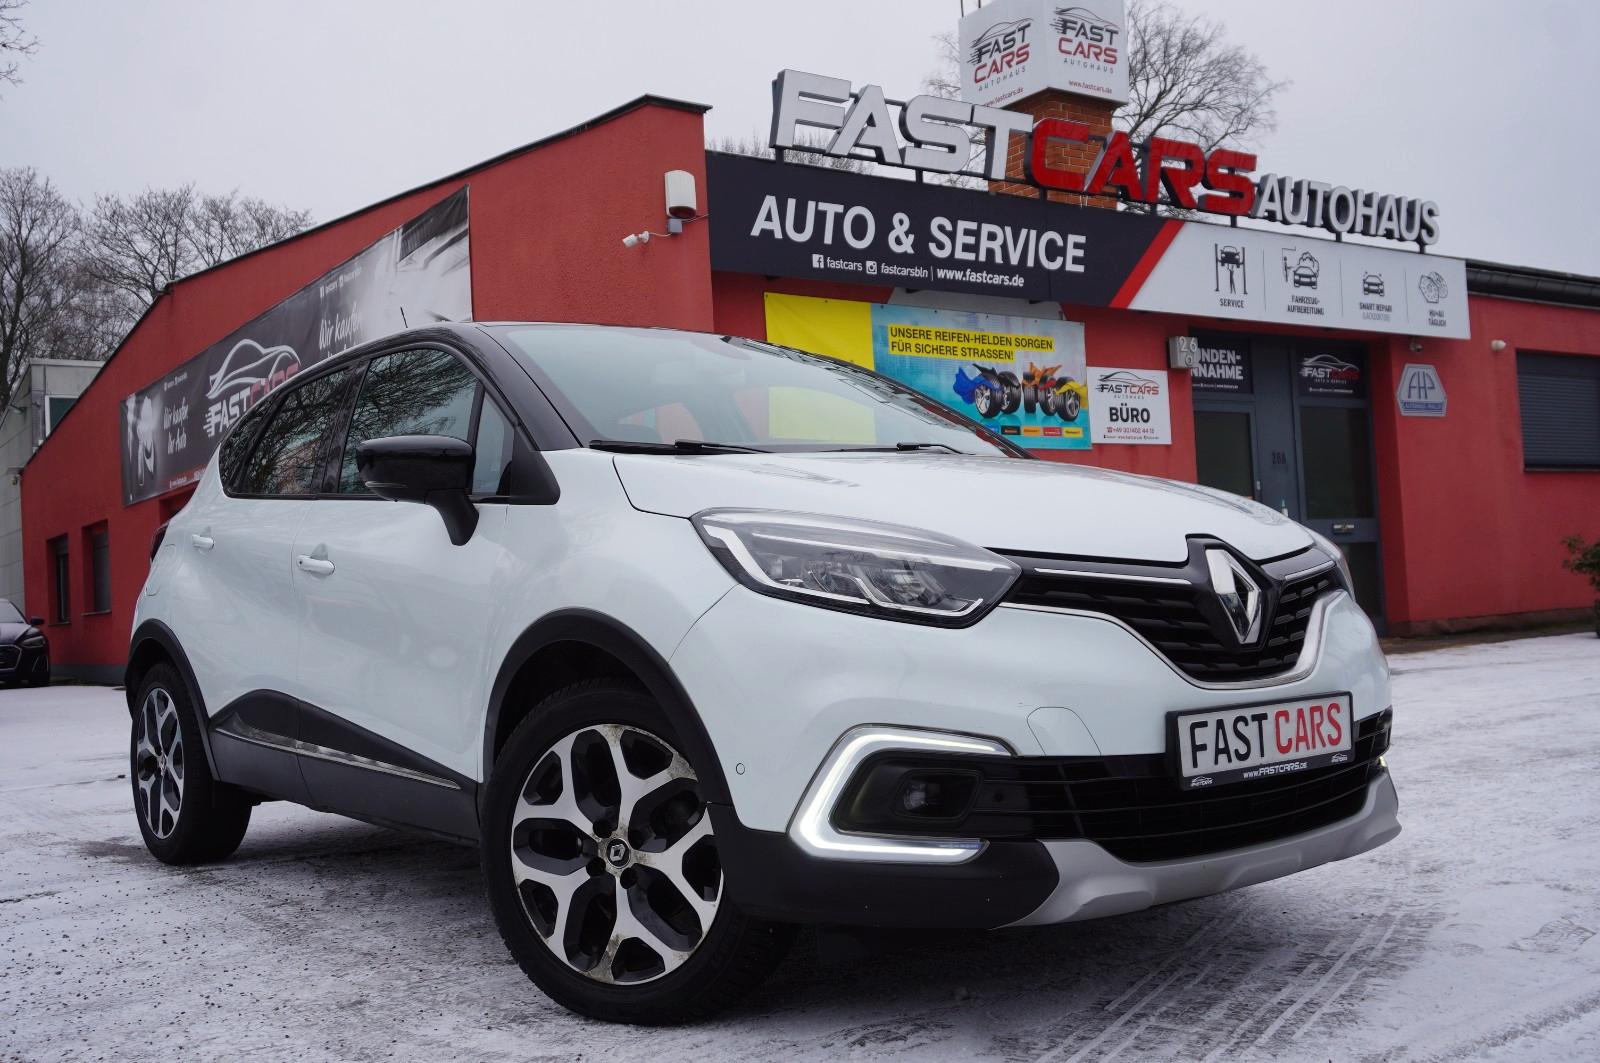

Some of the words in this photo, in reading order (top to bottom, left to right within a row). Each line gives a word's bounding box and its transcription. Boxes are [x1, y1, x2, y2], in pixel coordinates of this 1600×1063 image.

[1051, 17, 1119, 45] FAST
[967, 23, 1031, 66] FAST
[1058, 36, 1118, 65] CARS
[974, 43, 1030, 84] CARS
[1063, 57, 1114, 74] AUTOHAUS
[978, 66, 1026, 91] AUTOHAUS
[1068, 79, 1113, 94] www.fastcars.de
[1251, 173, 1440, 245] AUTOHAUS
[750, 195, 876, 250] AUTO
[888, 212, 915, 254] &
[928, 216, 1087, 273] SERVICE
[826, 256, 863, 272] fastcars
[881, 263, 929, 279] fastcarsbln
[936, 267, 1025, 288] www.fastcars.de
[1219, 298, 1245, 309] SERVICE
[890, 327, 932, 340] UNSERE
[935, 331, 1012, 346] REIFEN-HELDEN
[1014, 337, 1053, 350] SORGEN
[1178, 336, 1198, 352] 26
[891, 341, 912, 354] FÜR
[914, 343, 958, 356] SICHERE
[960, 346, 1014, 361] STRASSEN!
[1198, 347, 1242, 365] NDEN-
[1109, 402, 1151, 423] BÜRO
